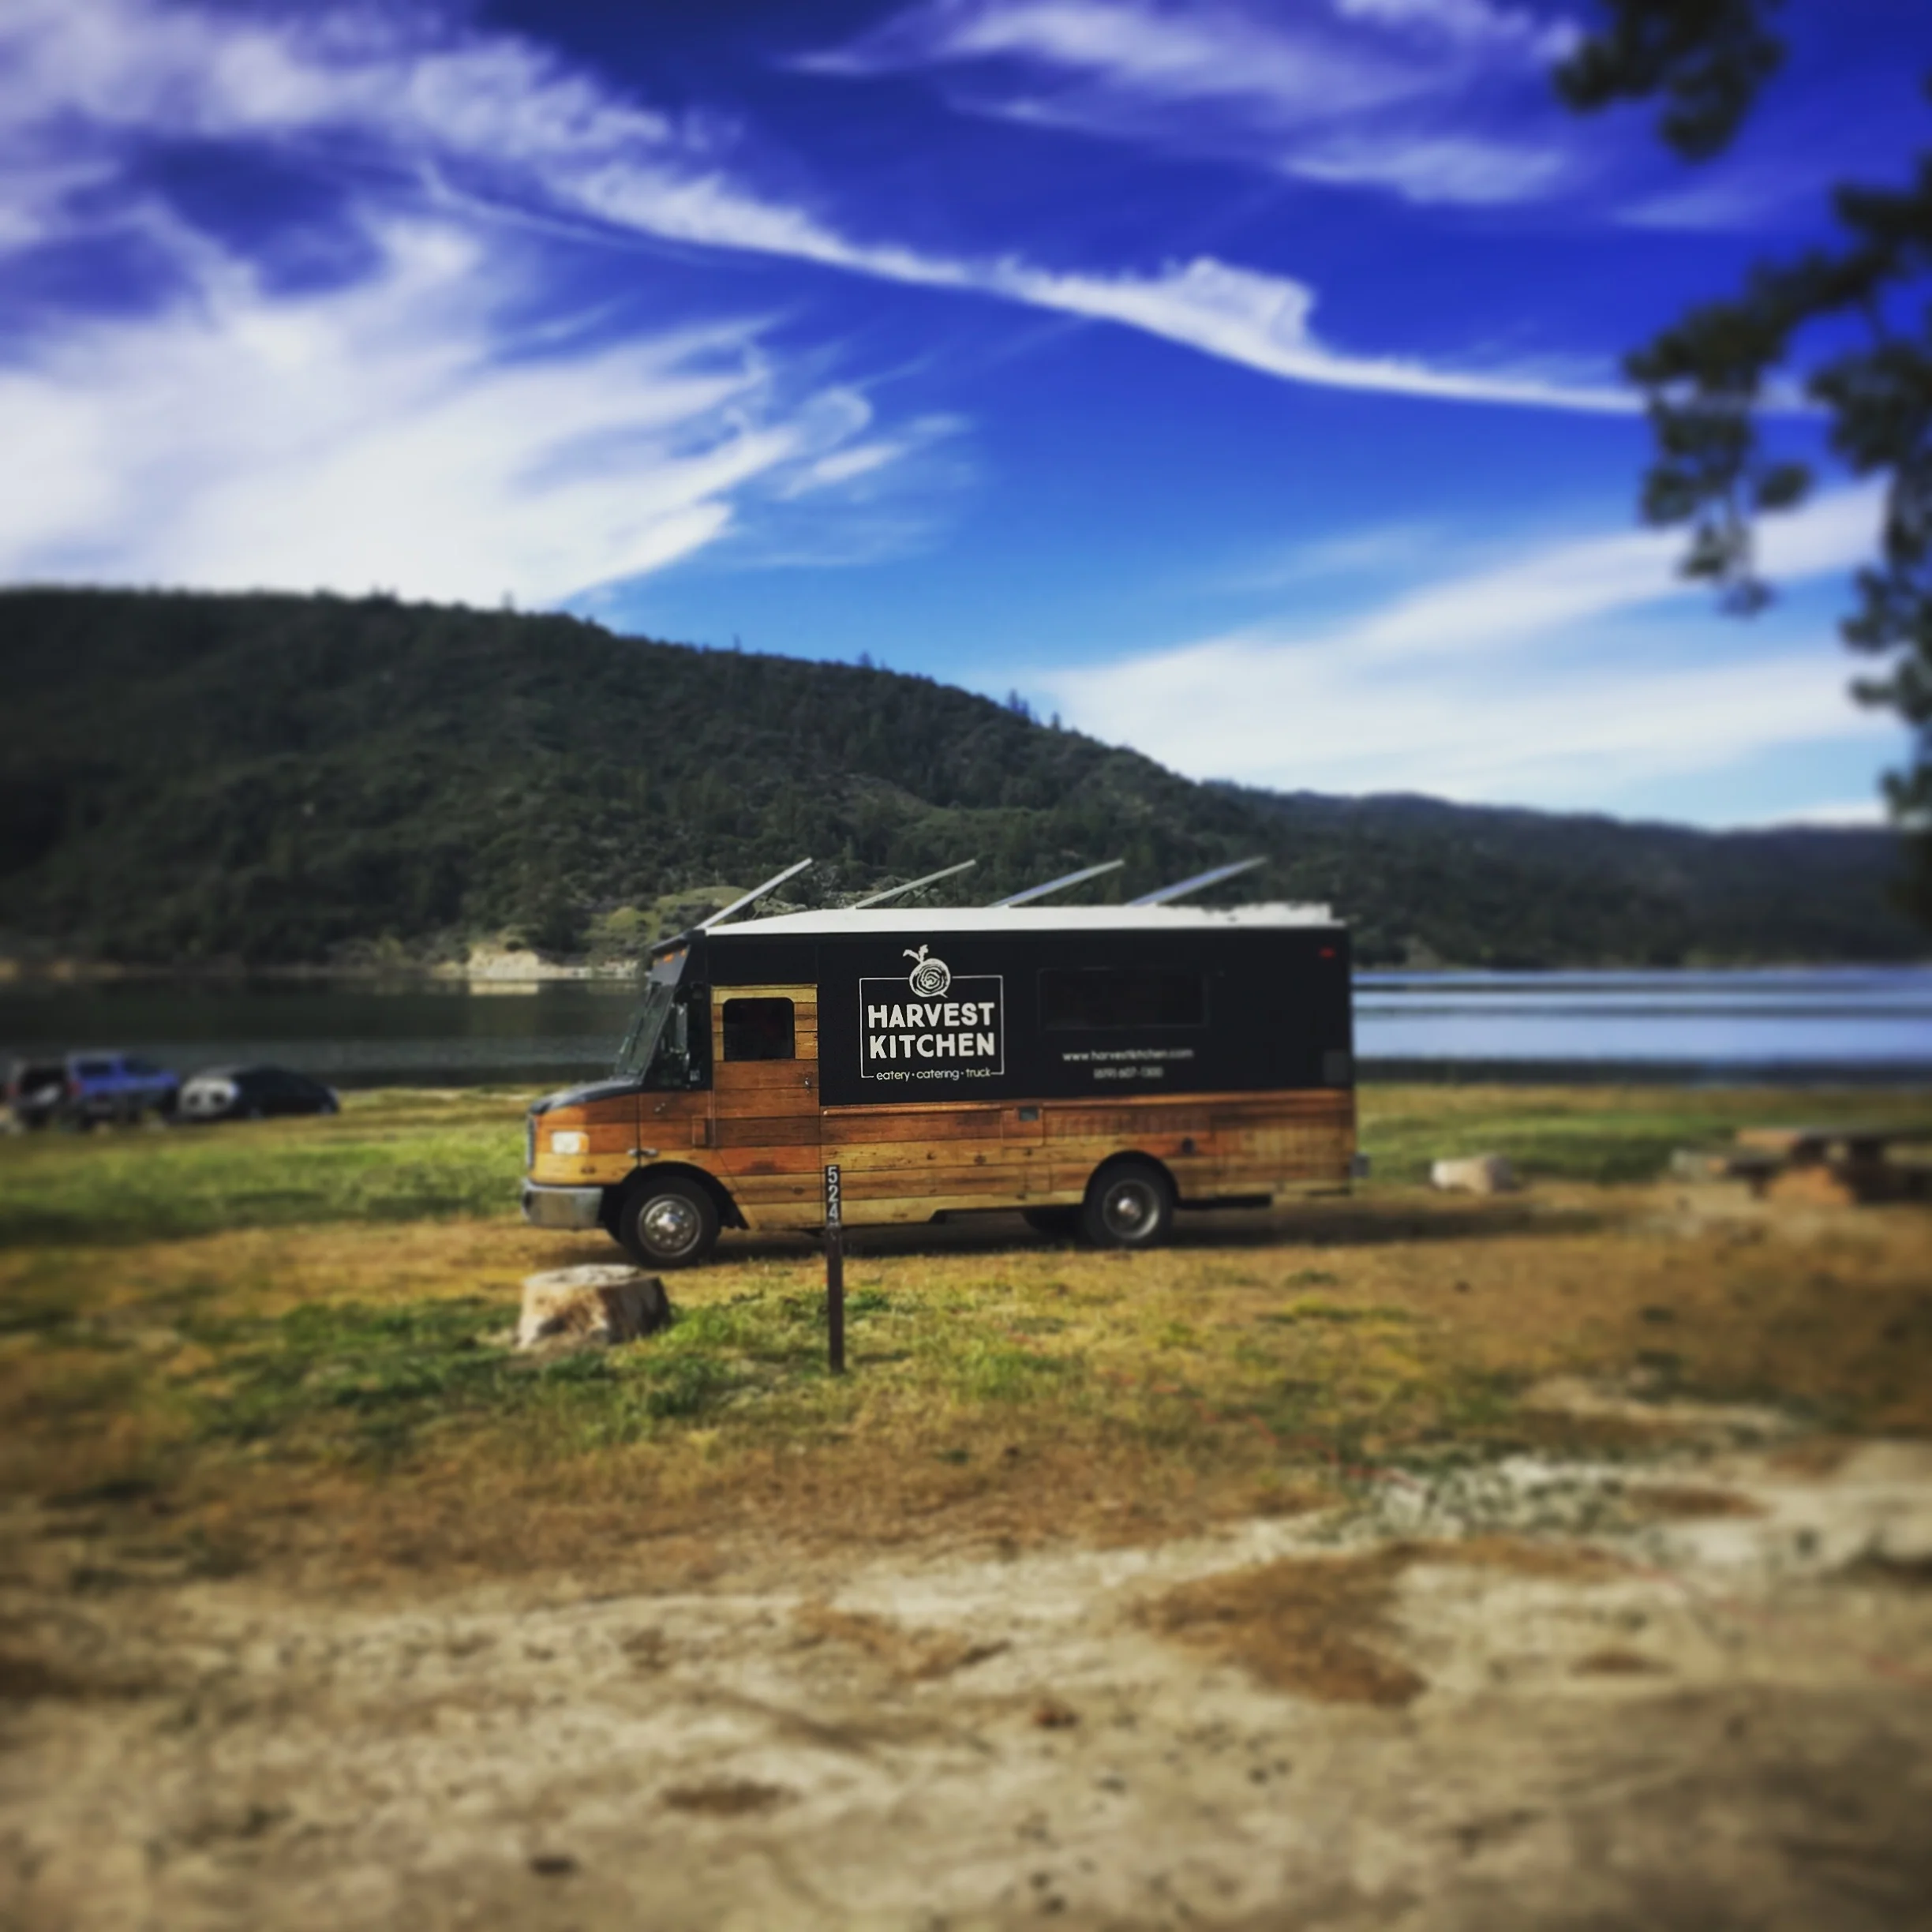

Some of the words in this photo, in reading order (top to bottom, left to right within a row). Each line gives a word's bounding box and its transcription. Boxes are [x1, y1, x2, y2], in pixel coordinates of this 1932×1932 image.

[868, 1002, 995, 1028] HARVEST
[870, 1032, 995, 1059] KITCHEN
[876, 1071, 911, 1082] eatery
[916, 1069, 960, 1081] catering
[965, 1067, 991, 1078] truck
[828, 1166, 839, 1222] 524
